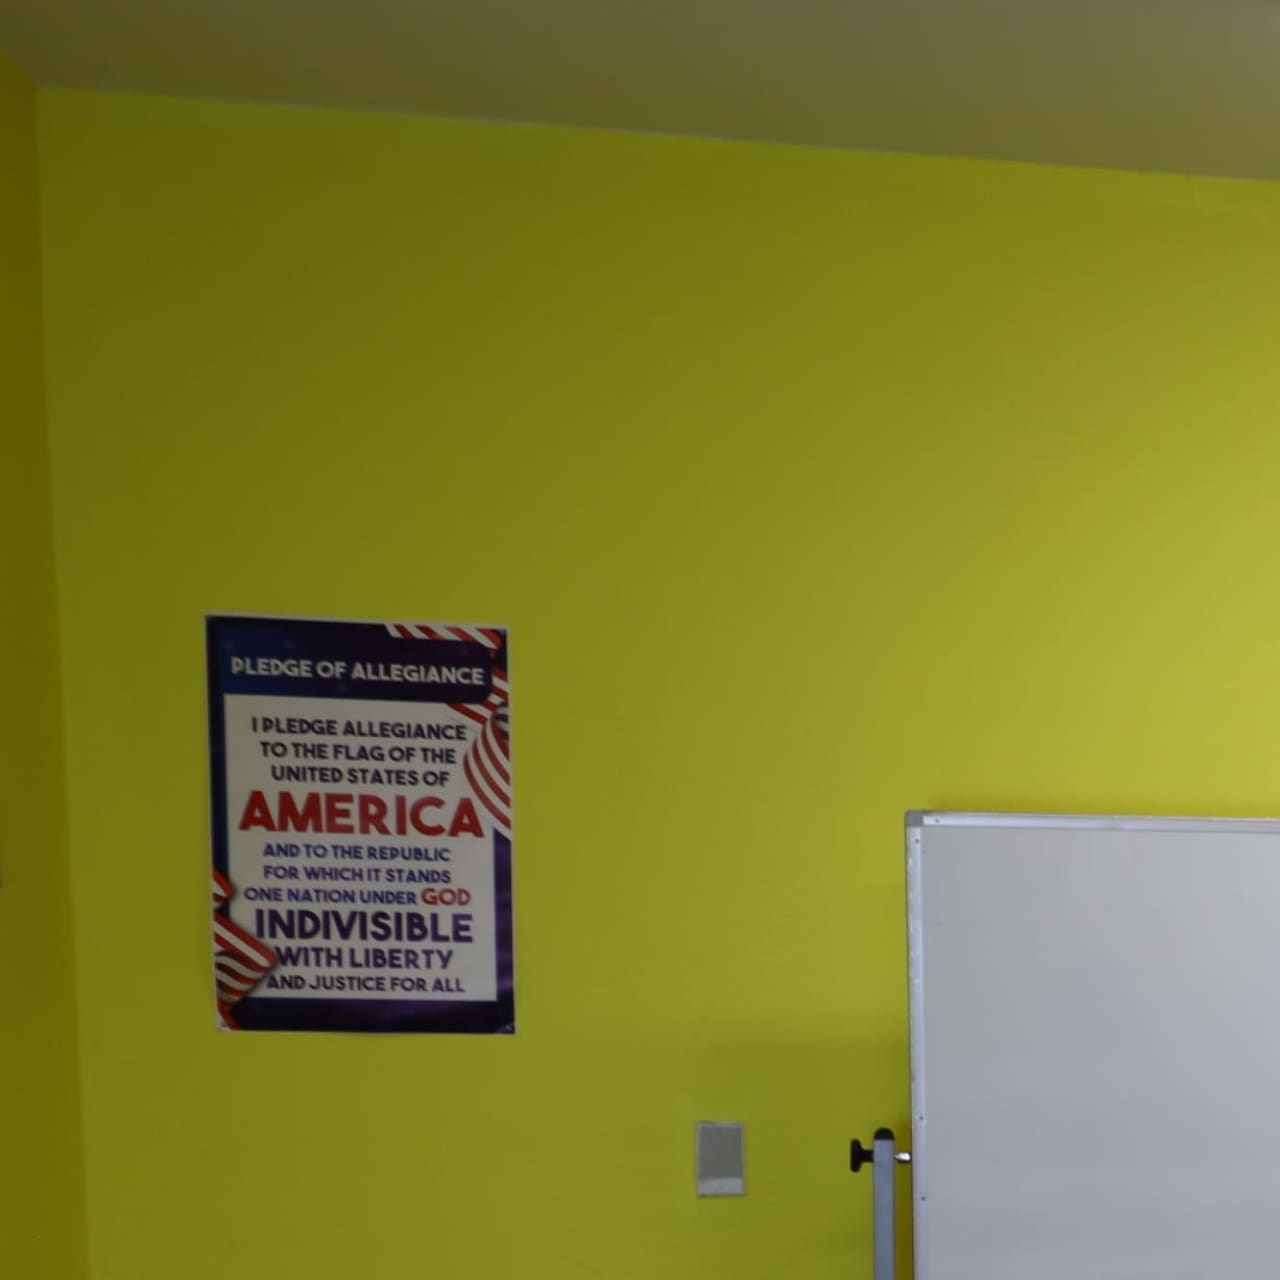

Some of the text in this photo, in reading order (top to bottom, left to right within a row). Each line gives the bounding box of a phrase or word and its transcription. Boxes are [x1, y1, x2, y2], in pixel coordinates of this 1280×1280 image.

[231, 657, 484, 685] PLEDGE OF ALLEGIANCE
[252, 717, 466, 741] I PLEDGE ALLEGIANCE
[261, 742, 456, 764] TO THE FLAG OF THE
[272, 765, 449, 787] UNITED STATES OF
[239, 790, 485, 838] AMERICA
[263, 844, 450, 862] AND TO THE REPUBLIC
[264, 865, 450, 883] FOR WHICH IT STANDS
[244, 887, 470, 907] ONE NATION UNDER GOD
[256, 908, 473, 942] INDIVISIBLE
[274, 947, 454, 970] WITH LIBERTY
[267, 975, 465, 992] AND JUSTICE FOR ALL
